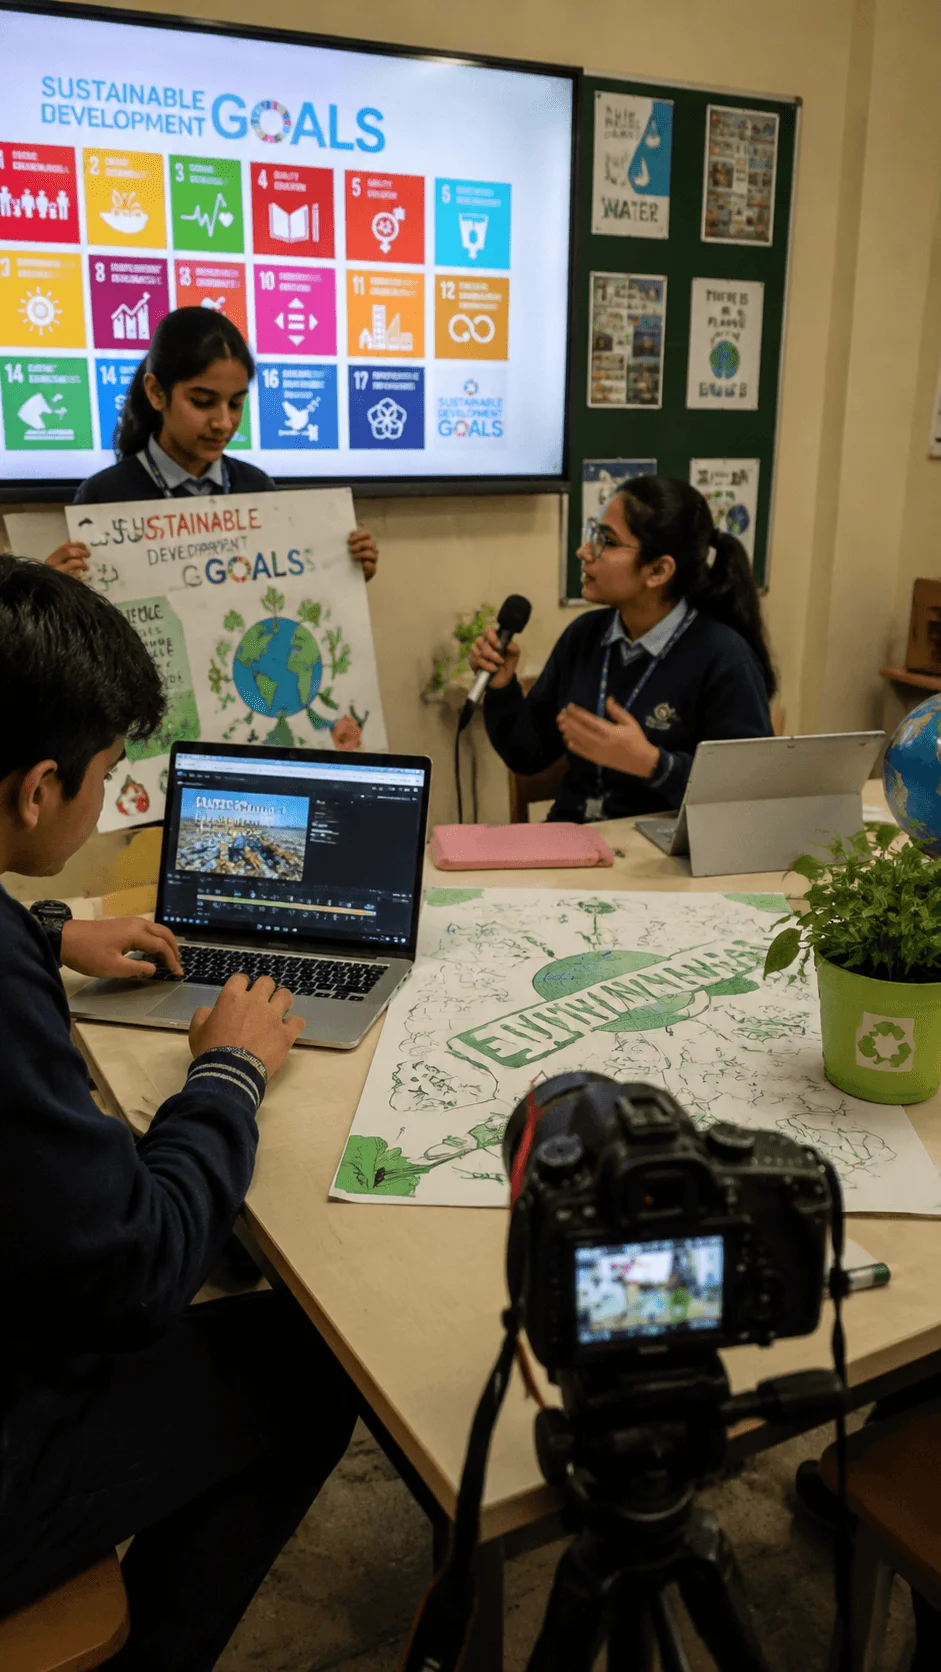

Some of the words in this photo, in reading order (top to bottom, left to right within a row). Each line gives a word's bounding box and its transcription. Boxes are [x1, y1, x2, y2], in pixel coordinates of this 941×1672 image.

[41, 75, 206, 111] SUSTAINABLE
[41, 103, 206, 137] DEVELOPMENT
[211, 92, 386, 153] GOALS
[89, 155, 100, 175] 2
[175, 162, 185, 182] 3
[257, 169, 268, 190] 4
[351, 176, 362, 198] 5
[602, 196, 659, 223] WATER
[94, 261, 106, 283] 8
[259, 271, 275, 291] 10
[352, 275, 365, 296] 11
[440, 280, 456, 300] 12
[4, 363, 24, 384] 14
[100, 365, 117, 385] 14
[262, 369, 280, 389] 16
[354, 370, 369, 391] 17
[437, 419, 505, 438] GOALS
